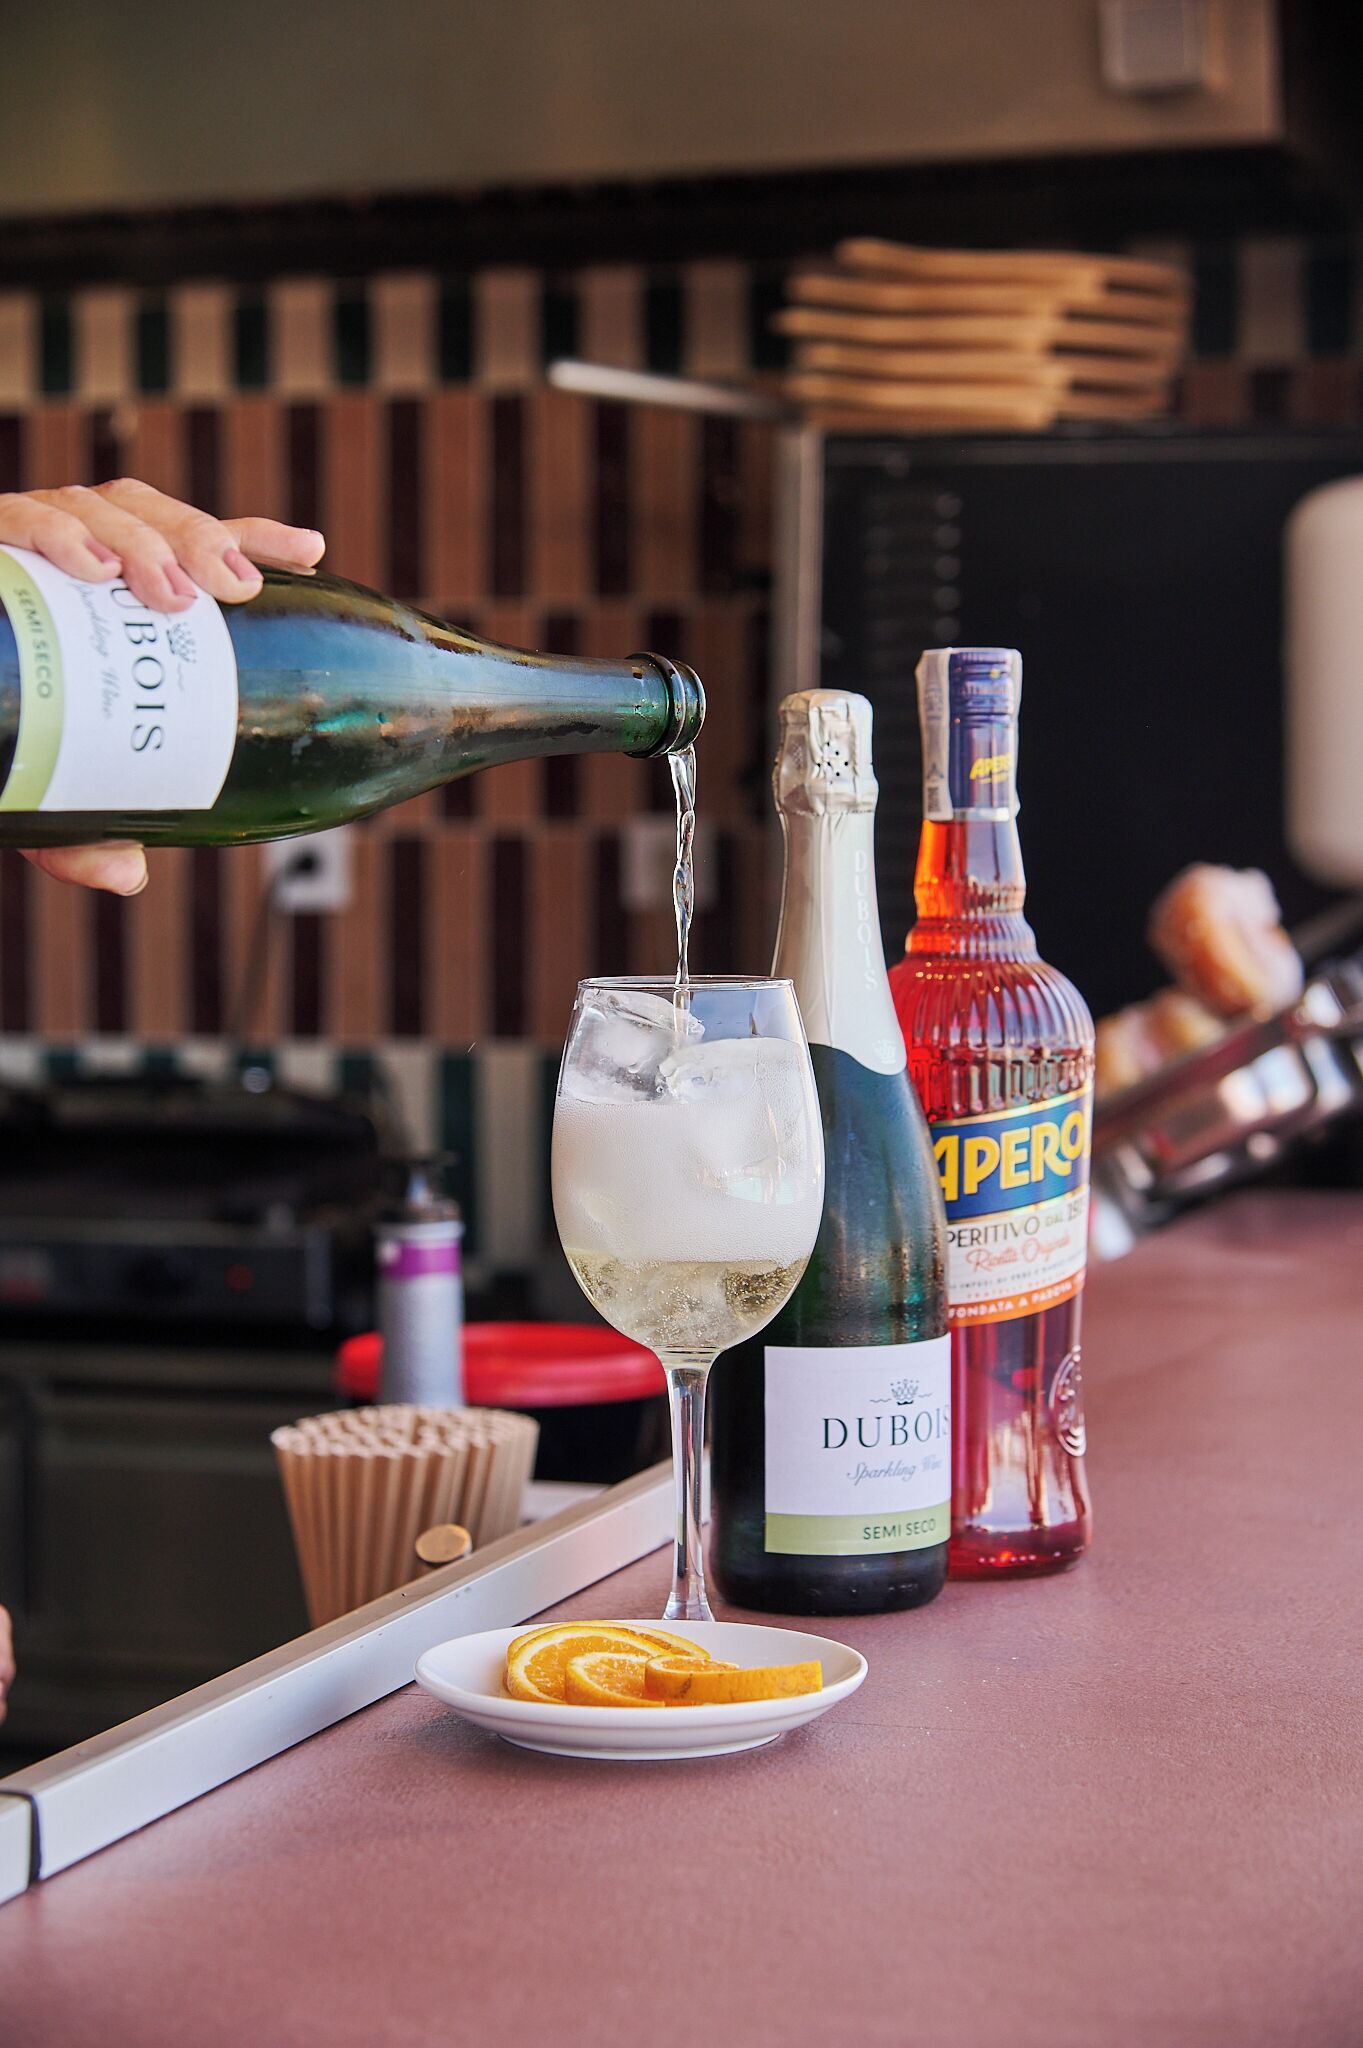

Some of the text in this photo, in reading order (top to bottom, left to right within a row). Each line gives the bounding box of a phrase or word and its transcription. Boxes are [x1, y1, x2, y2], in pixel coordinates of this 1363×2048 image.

[14, 588, 52, 700] SEMI SECO
[110, 586, 166, 753] UBOIS
[854, 849, 879, 991] DUBOIS
[932, 1105, 1092, 1201] APERO
[947, 1216, 1041, 1248] PERITIVO
[948, 1300, 1014, 1319] FONDATA
[1018, 1297, 1029, 1308] A
[822, 1404, 949, 1449] DUBOIS
[846, 1460, 916, 1486] Sparkling
[863, 1518, 937, 1540] SEMI SECO
